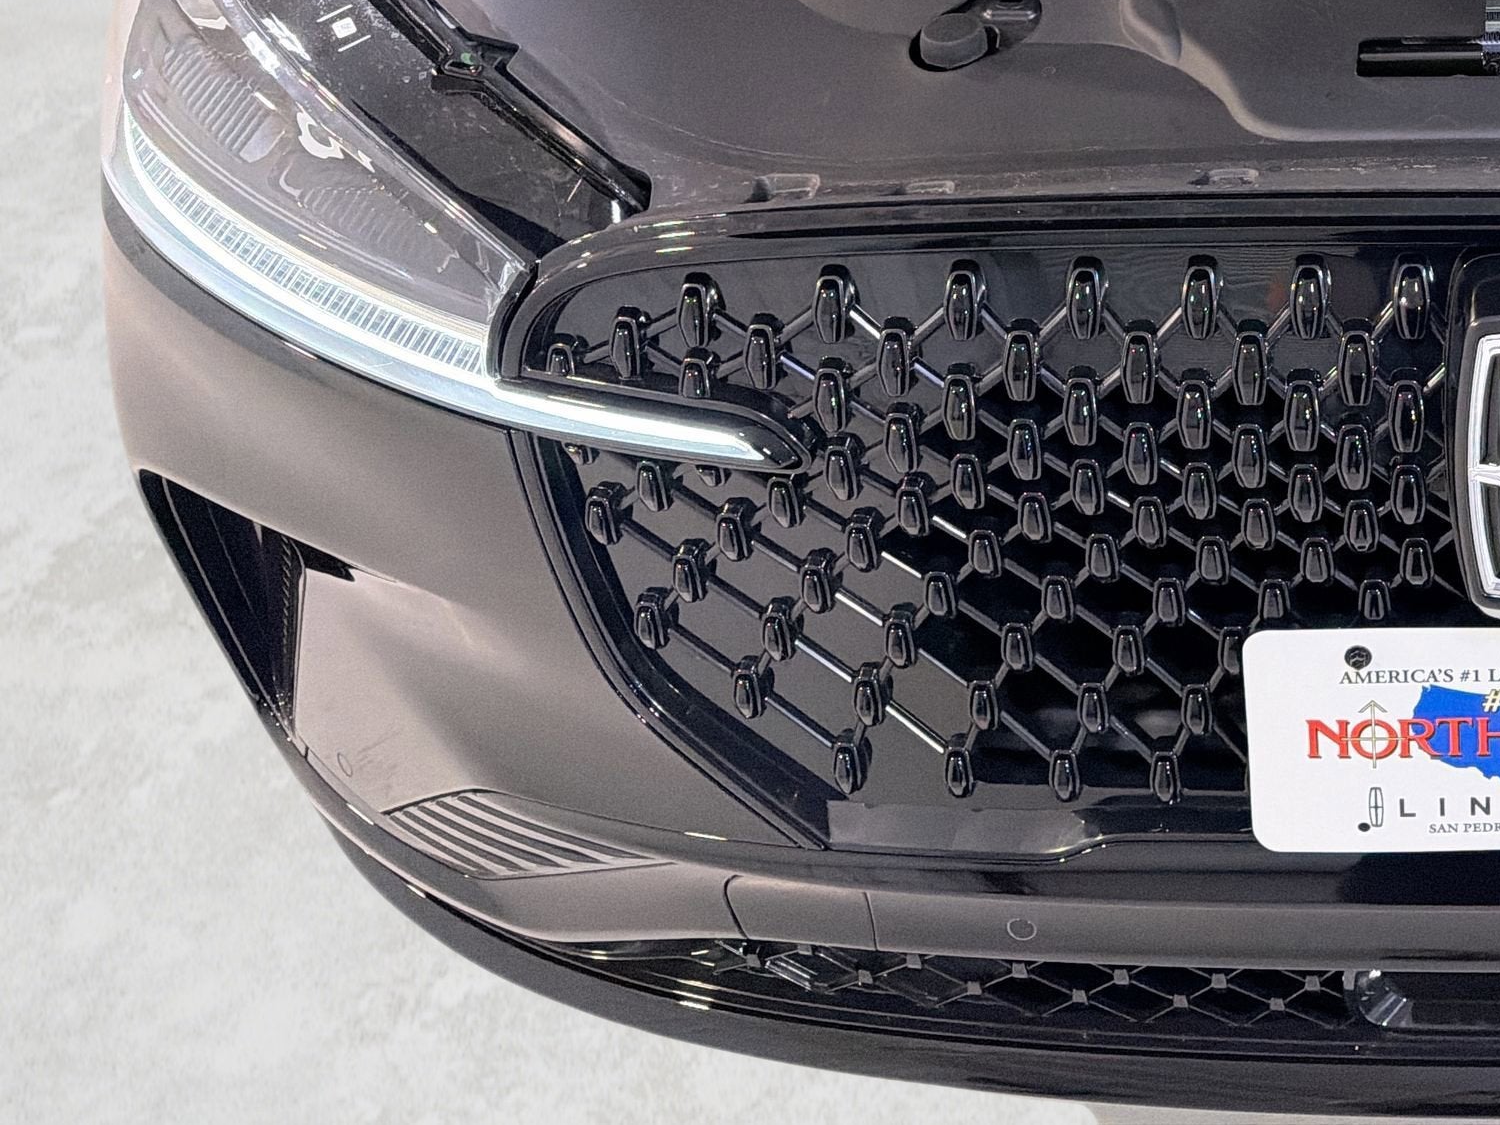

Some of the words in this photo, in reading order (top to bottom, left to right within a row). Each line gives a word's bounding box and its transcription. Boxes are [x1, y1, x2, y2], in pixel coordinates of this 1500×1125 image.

[1340, 669, 1454, 685] AMERICA'S
[1460, 668, 1482, 683] #1
[1429, 823, 1460, 834] SAN
